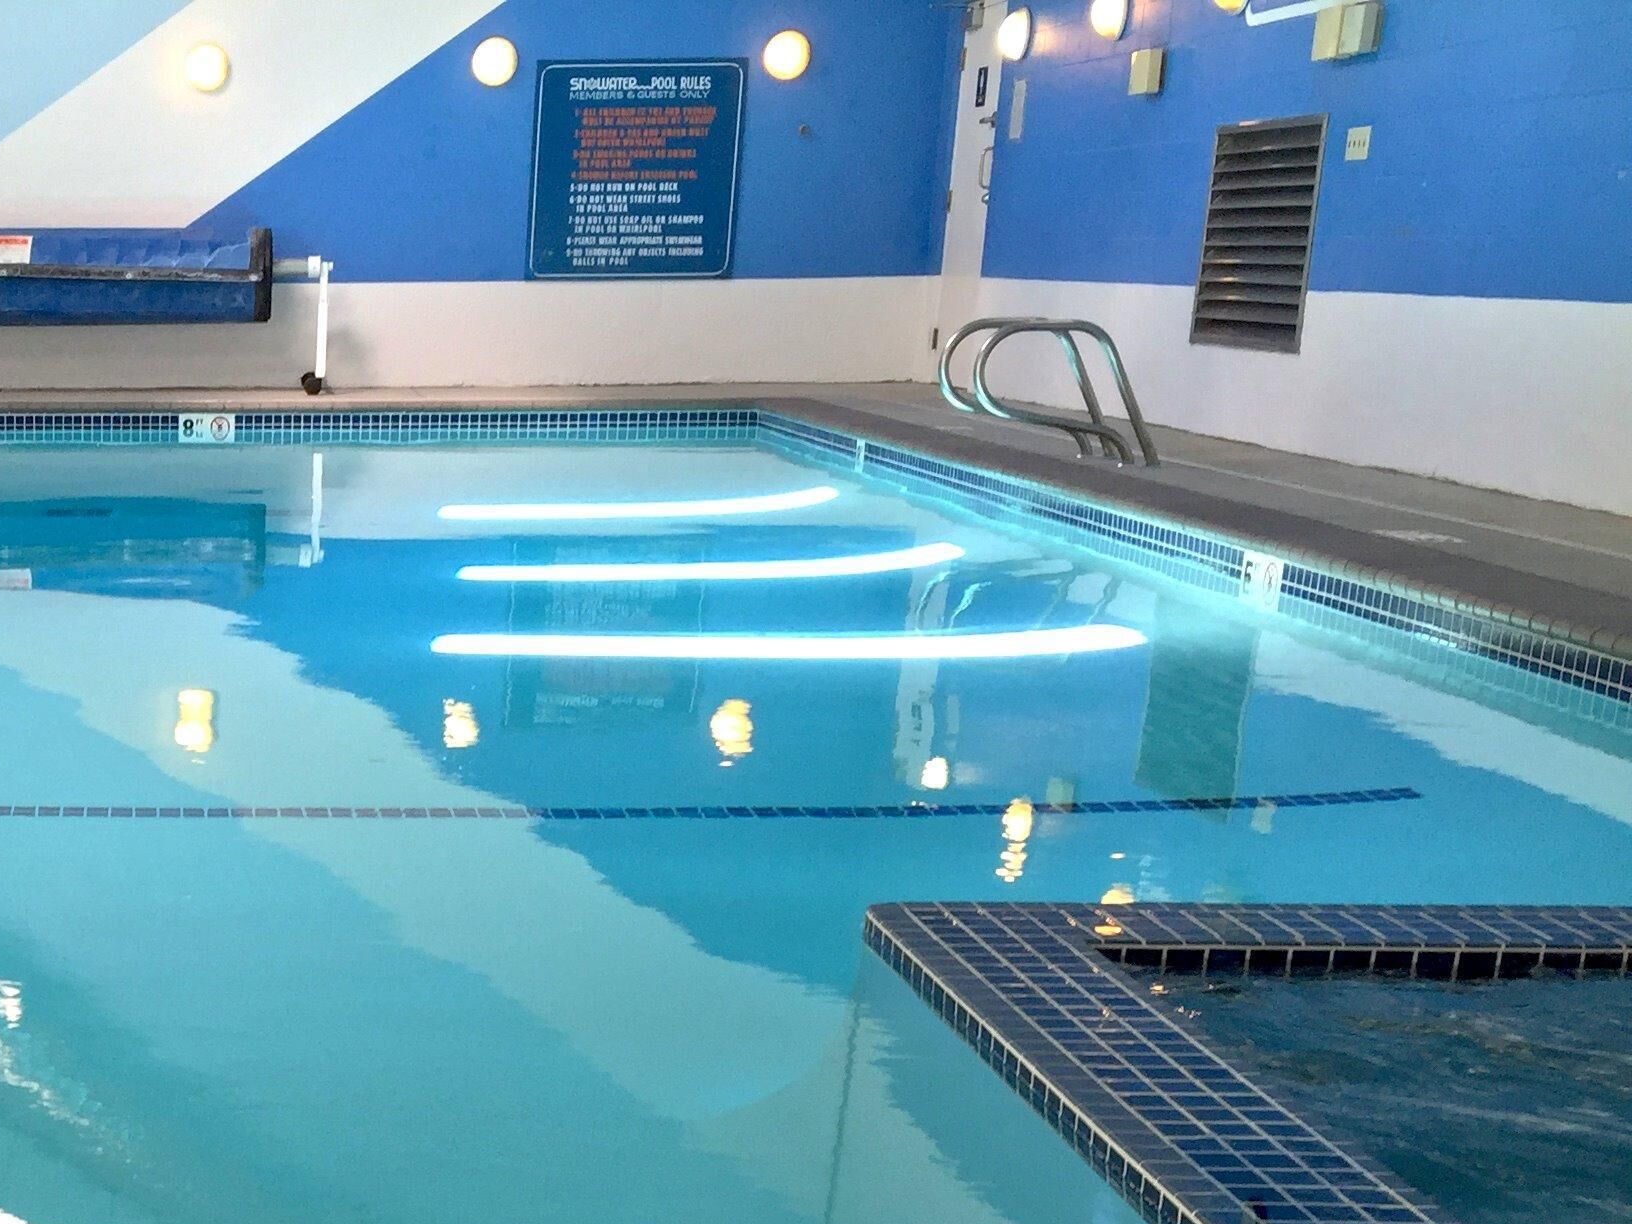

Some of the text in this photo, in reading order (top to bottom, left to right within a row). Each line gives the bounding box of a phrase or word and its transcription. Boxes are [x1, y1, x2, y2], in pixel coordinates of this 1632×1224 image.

[680, 76, 711, 89] RULES
[569, 90, 710, 100] MEMBERS & GUESTS ONLY
[590, 183, 604, 192] NOT
[606, 183, 622, 192] RUN
[625, 183, 636, 191] ON
[637, 182, 656, 191] POOL
[659, 182, 678, 191] DECK
[589, 195, 604, 204] NOT
[606, 195, 627, 204] WEAR
[629, 194, 656, 204] STREET
[658, 194, 681, 204] SHOES
[576, 204, 628, 213] IN POOL AREA
[587, 216, 602, 224] NOT
[604, 216, 617, 224] USE
[620, 216, 639, 224] SOAP
[641, 215, 653, 224] OIL
[656, 215, 666, 224] OR
[668, 215, 704, 224] SHAMPOO
[574, 224, 662, 234] IN POOL OR WHIRLPOOL
[598, 236, 617, 245] WEAR
[620, 235, 663, 245] APPROPRIATE
[585, 248, 620, 256] THROWING
[622, 248, 636, 256] ANY
[638, 248, 666, 256] OBJECTS
[668, 247, 704, 256] INCLUDING
[572, 257, 595, 266] BALLS
[609, 257, 628, 265] POOL
